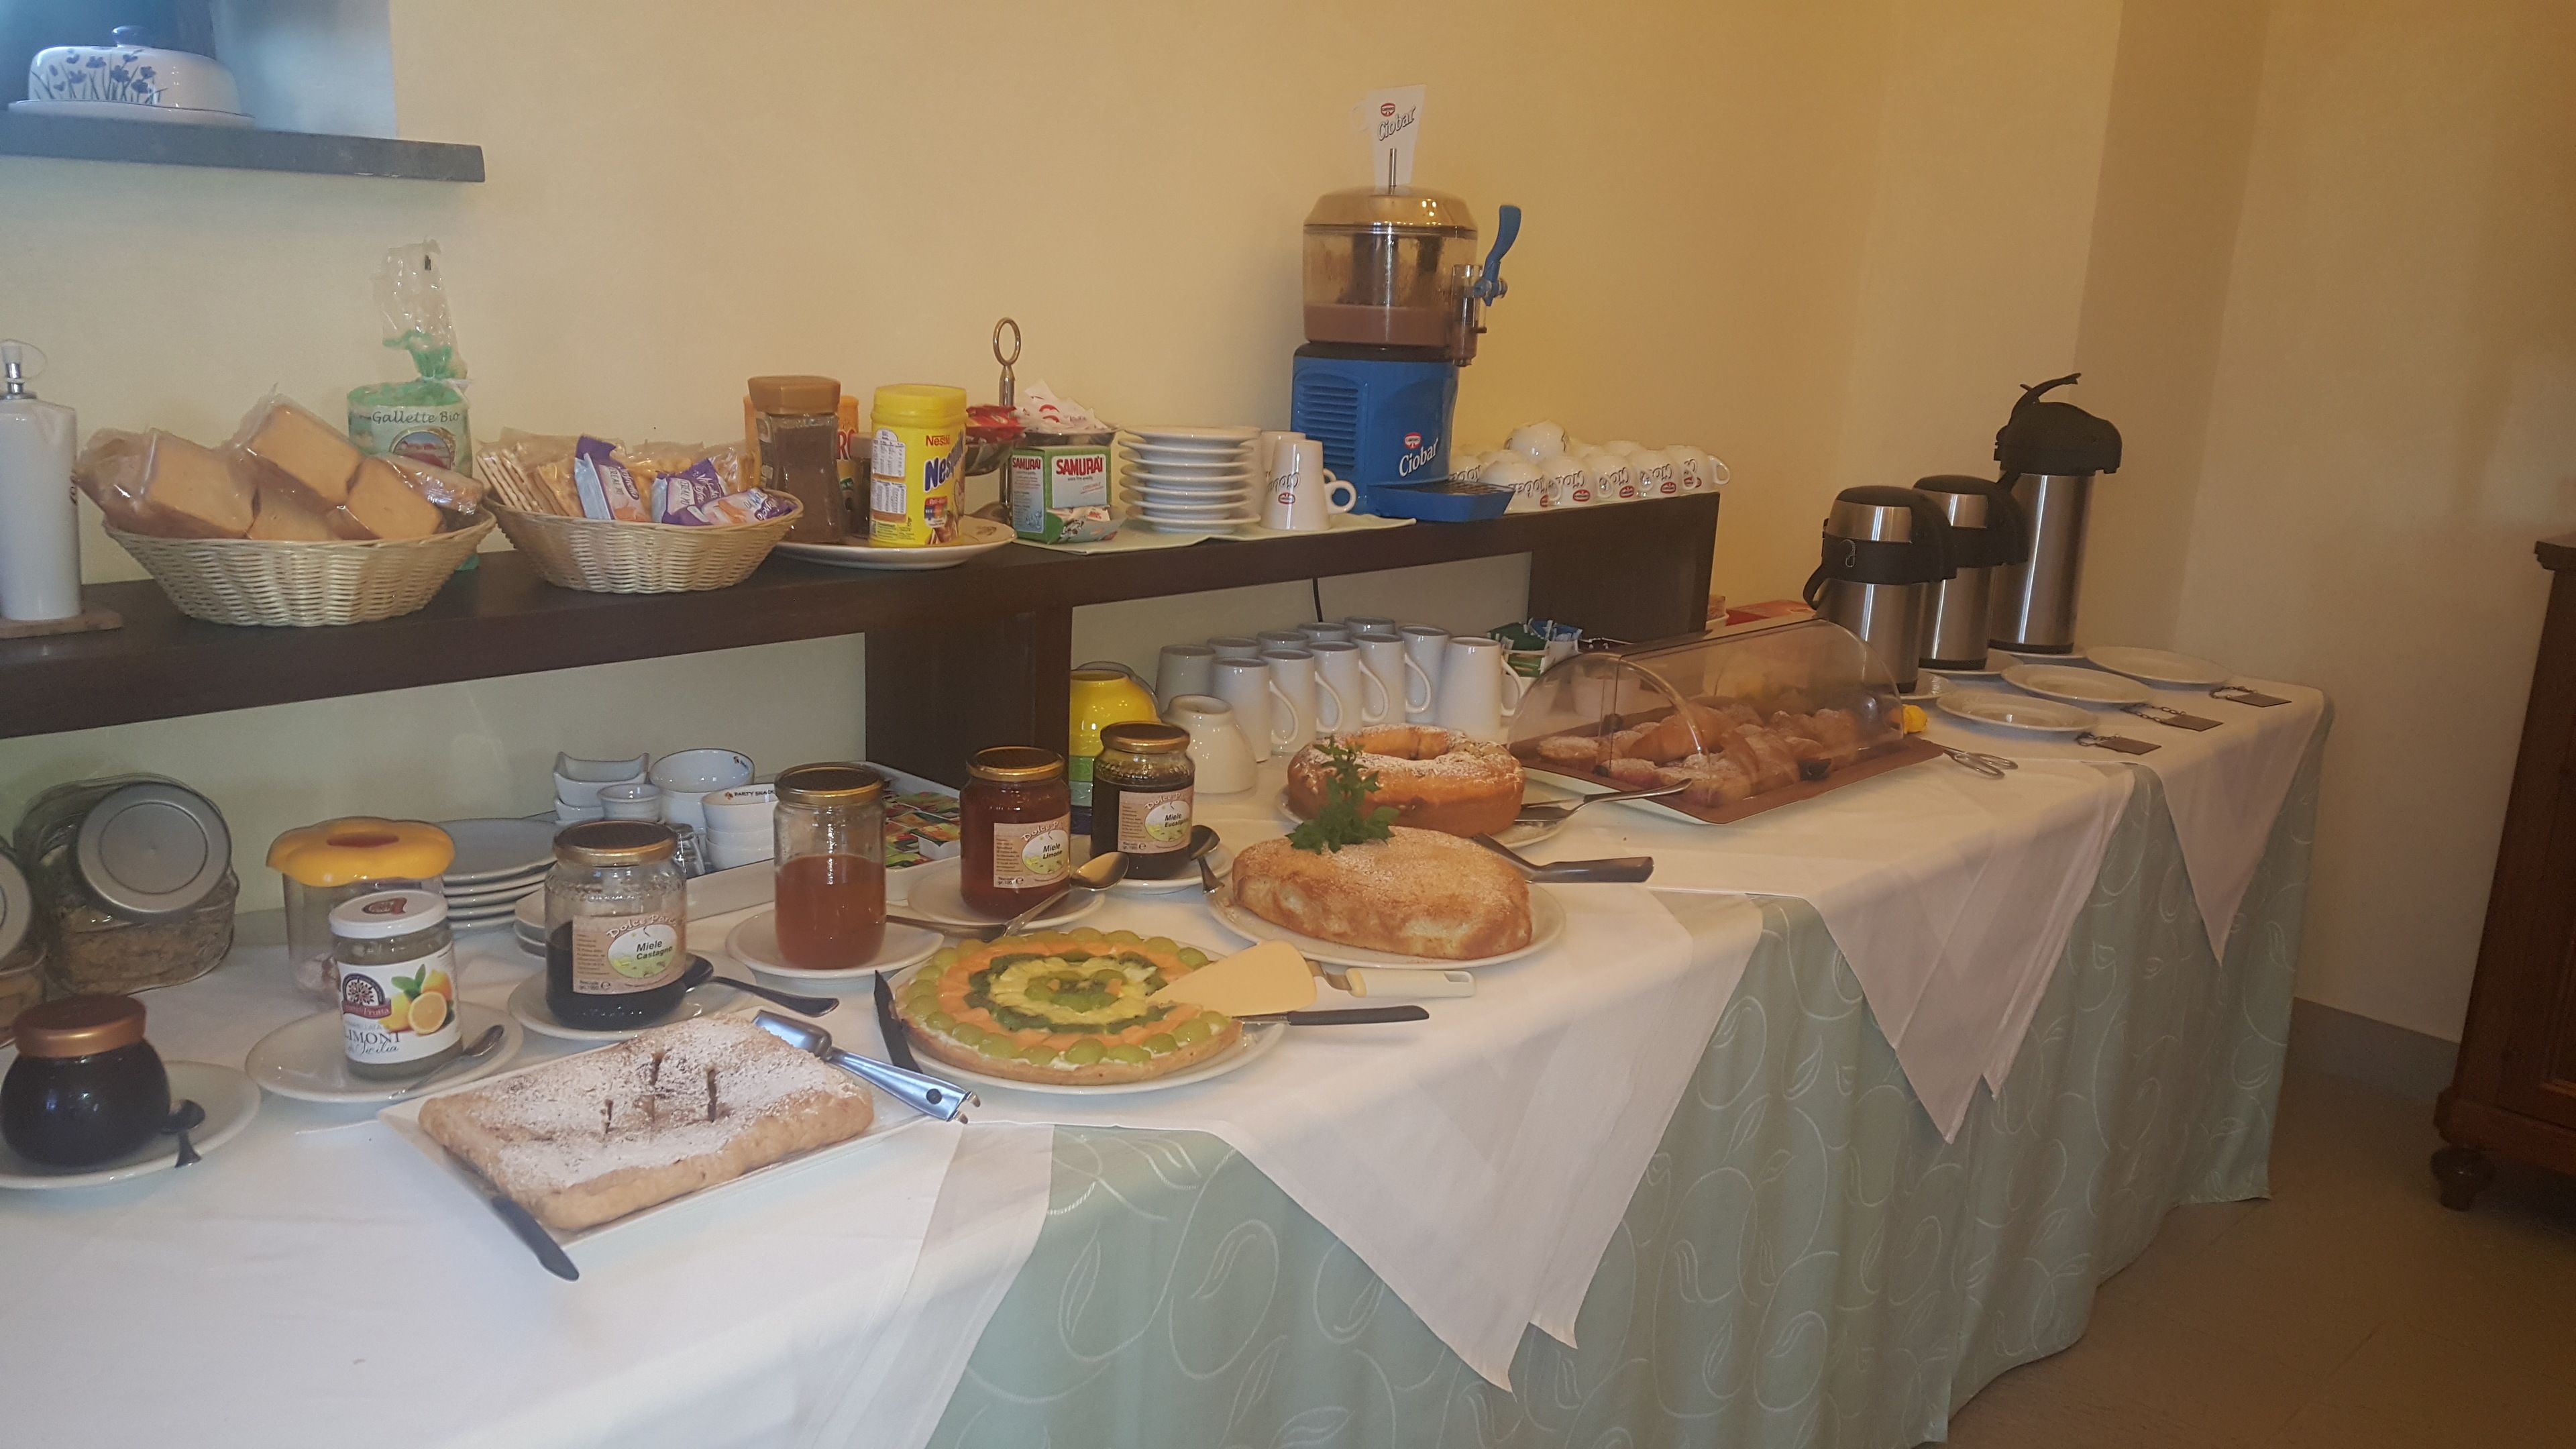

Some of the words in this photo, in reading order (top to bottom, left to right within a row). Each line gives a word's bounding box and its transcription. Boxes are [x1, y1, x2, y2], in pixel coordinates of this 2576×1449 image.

[1378, 105, 1416, 142] Ciobar
[372, 411, 436, 425] Gallette
[439, 411, 461, 423] Bio
[1398, 436, 1440, 478] Ciobar
[1165, 813, 1182, 822] Miele
[1042, 843, 1061, 853] Miele
[1042, 850, 1063, 859] Limone
[606, 917, 646, 938] Dolce
[636, 939, 663, 953] Miele
[636, 946, 673, 960] Castagno
